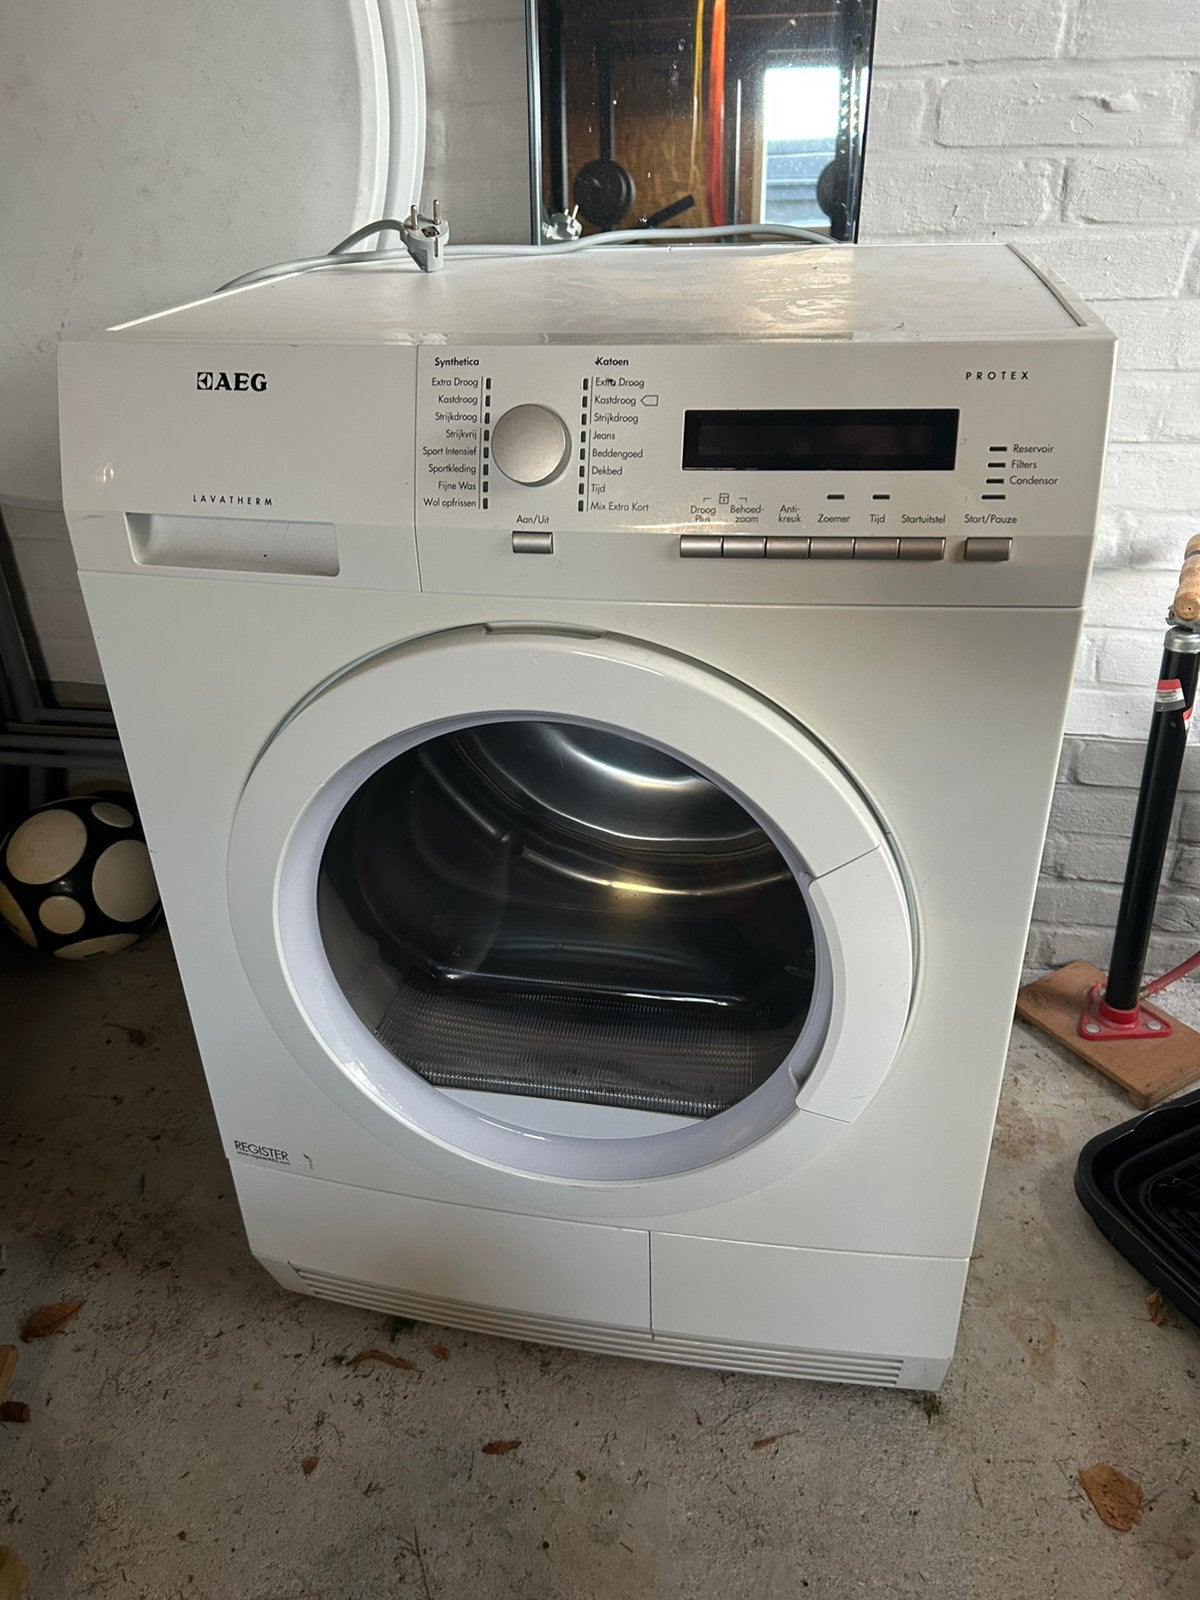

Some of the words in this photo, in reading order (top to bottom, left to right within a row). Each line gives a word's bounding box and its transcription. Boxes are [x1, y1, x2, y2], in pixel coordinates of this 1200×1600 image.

[434, 357, 480, 368] Synthetica
[596, 357, 629, 367] Katoen
[965, 371, 1029, 381] PROTEX
[214, 372, 268, 392] AEG
[431, 378, 452, 387] Extra
[453, 378, 479, 388] Droog
[618, 378, 645, 389] Droog
[438, 395, 478, 406] Kastdroog
[594, 395, 637, 406] Kastdroog
[434, 412, 478, 423] Strijkdroog
[593, 413, 639, 424] Strijkdroog
[445, 429, 478, 441] Strijkvrij
[592, 431, 616, 441] Jeans
[422, 446, 444, 457] Sport
[445, 446, 478, 456] Intensief
[592, 449, 644, 460] Beddengoed
[1012, 444, 1054, 454] Reservoir
[428, 463, 477, 475] Sportkleding
[1011, 460, 1038, 470] Filters
[591, 466, 623, 476] Dekbed
[438, 481, 457, 491] Fijne
[458, 481, 477, 490] Was
[1009, 476, 1059, 486] Condensor
[591, 483, 606, 494] Tijd
[193, 494, 273, 506] LAVATHERM
[423, 498, 441, 507] Wol
[441, 498, 477, 509] opfrissen
[590, 502, 607, 511] Mix
[608, 502, 630, 512] Extra
[631, 503, 650, 512] Kort
[690, 505, 716, 517] Droog
[730, 505, 764, 515] Behoed-
[779, 505, 801, 514] Anti-
[516, 515, 550, 525] Aan/Uit
[735, 515, 759, 524] zaam
[778, 513, 802, 523] kreuk
[817, 514, 850, 524] Zoemer
[870, 514, 886, 526] Tijd
[901, 514, 947, 524] Startuitstel
[964, 514, 1018, 526] Start/Pauze
[234, 1140, 290, 1161] REGISTER
